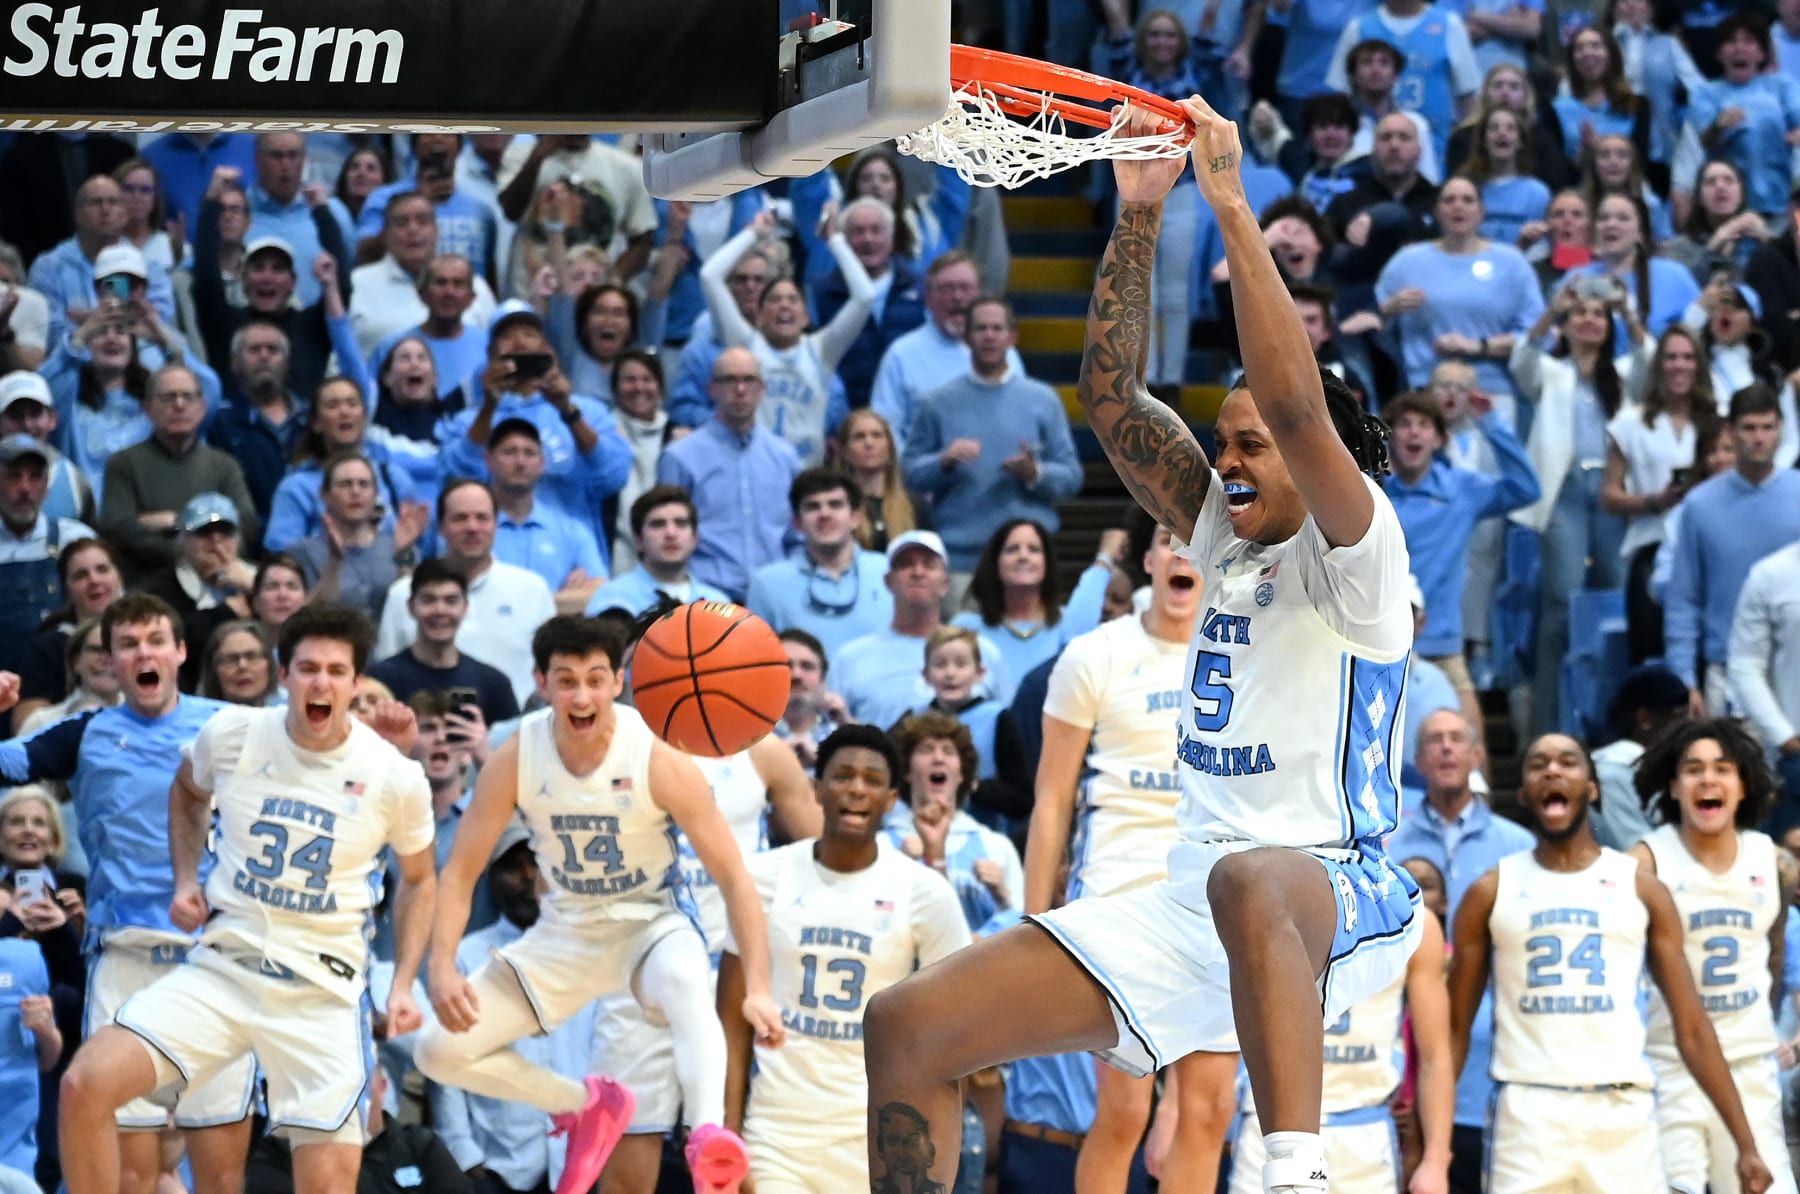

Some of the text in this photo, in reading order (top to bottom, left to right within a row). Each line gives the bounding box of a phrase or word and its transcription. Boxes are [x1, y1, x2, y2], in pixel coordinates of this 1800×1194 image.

[3, 3, 404, 83] State Farm
[1191, 650, 1234, 732] 5
[1177, 724, 1276, 776] CAROLINA
[260, 798, 337, 833] NORTH
[551, 814, 620, 834] NORTH
[246, 820, 335, 891] 34
[557, 833, 625, 876] 14
[233, 870, 338, 913] CAROLINA
[551, 867, 648, 896] CAROLINA
[799, 926, 872, 955] NORTH
[1529, 908, 1600, 930] NORTH
[1688, 909, 1752, 931] NORTH
[1525, 933, 1605, 988] 24
[1702, 936, 1738, 987] 2
[800, 954, 866, 1012] 13
[1519, 995, 1615, 1014] CAROLINA
[781, 1008, 864, 1040] CAROLIN
